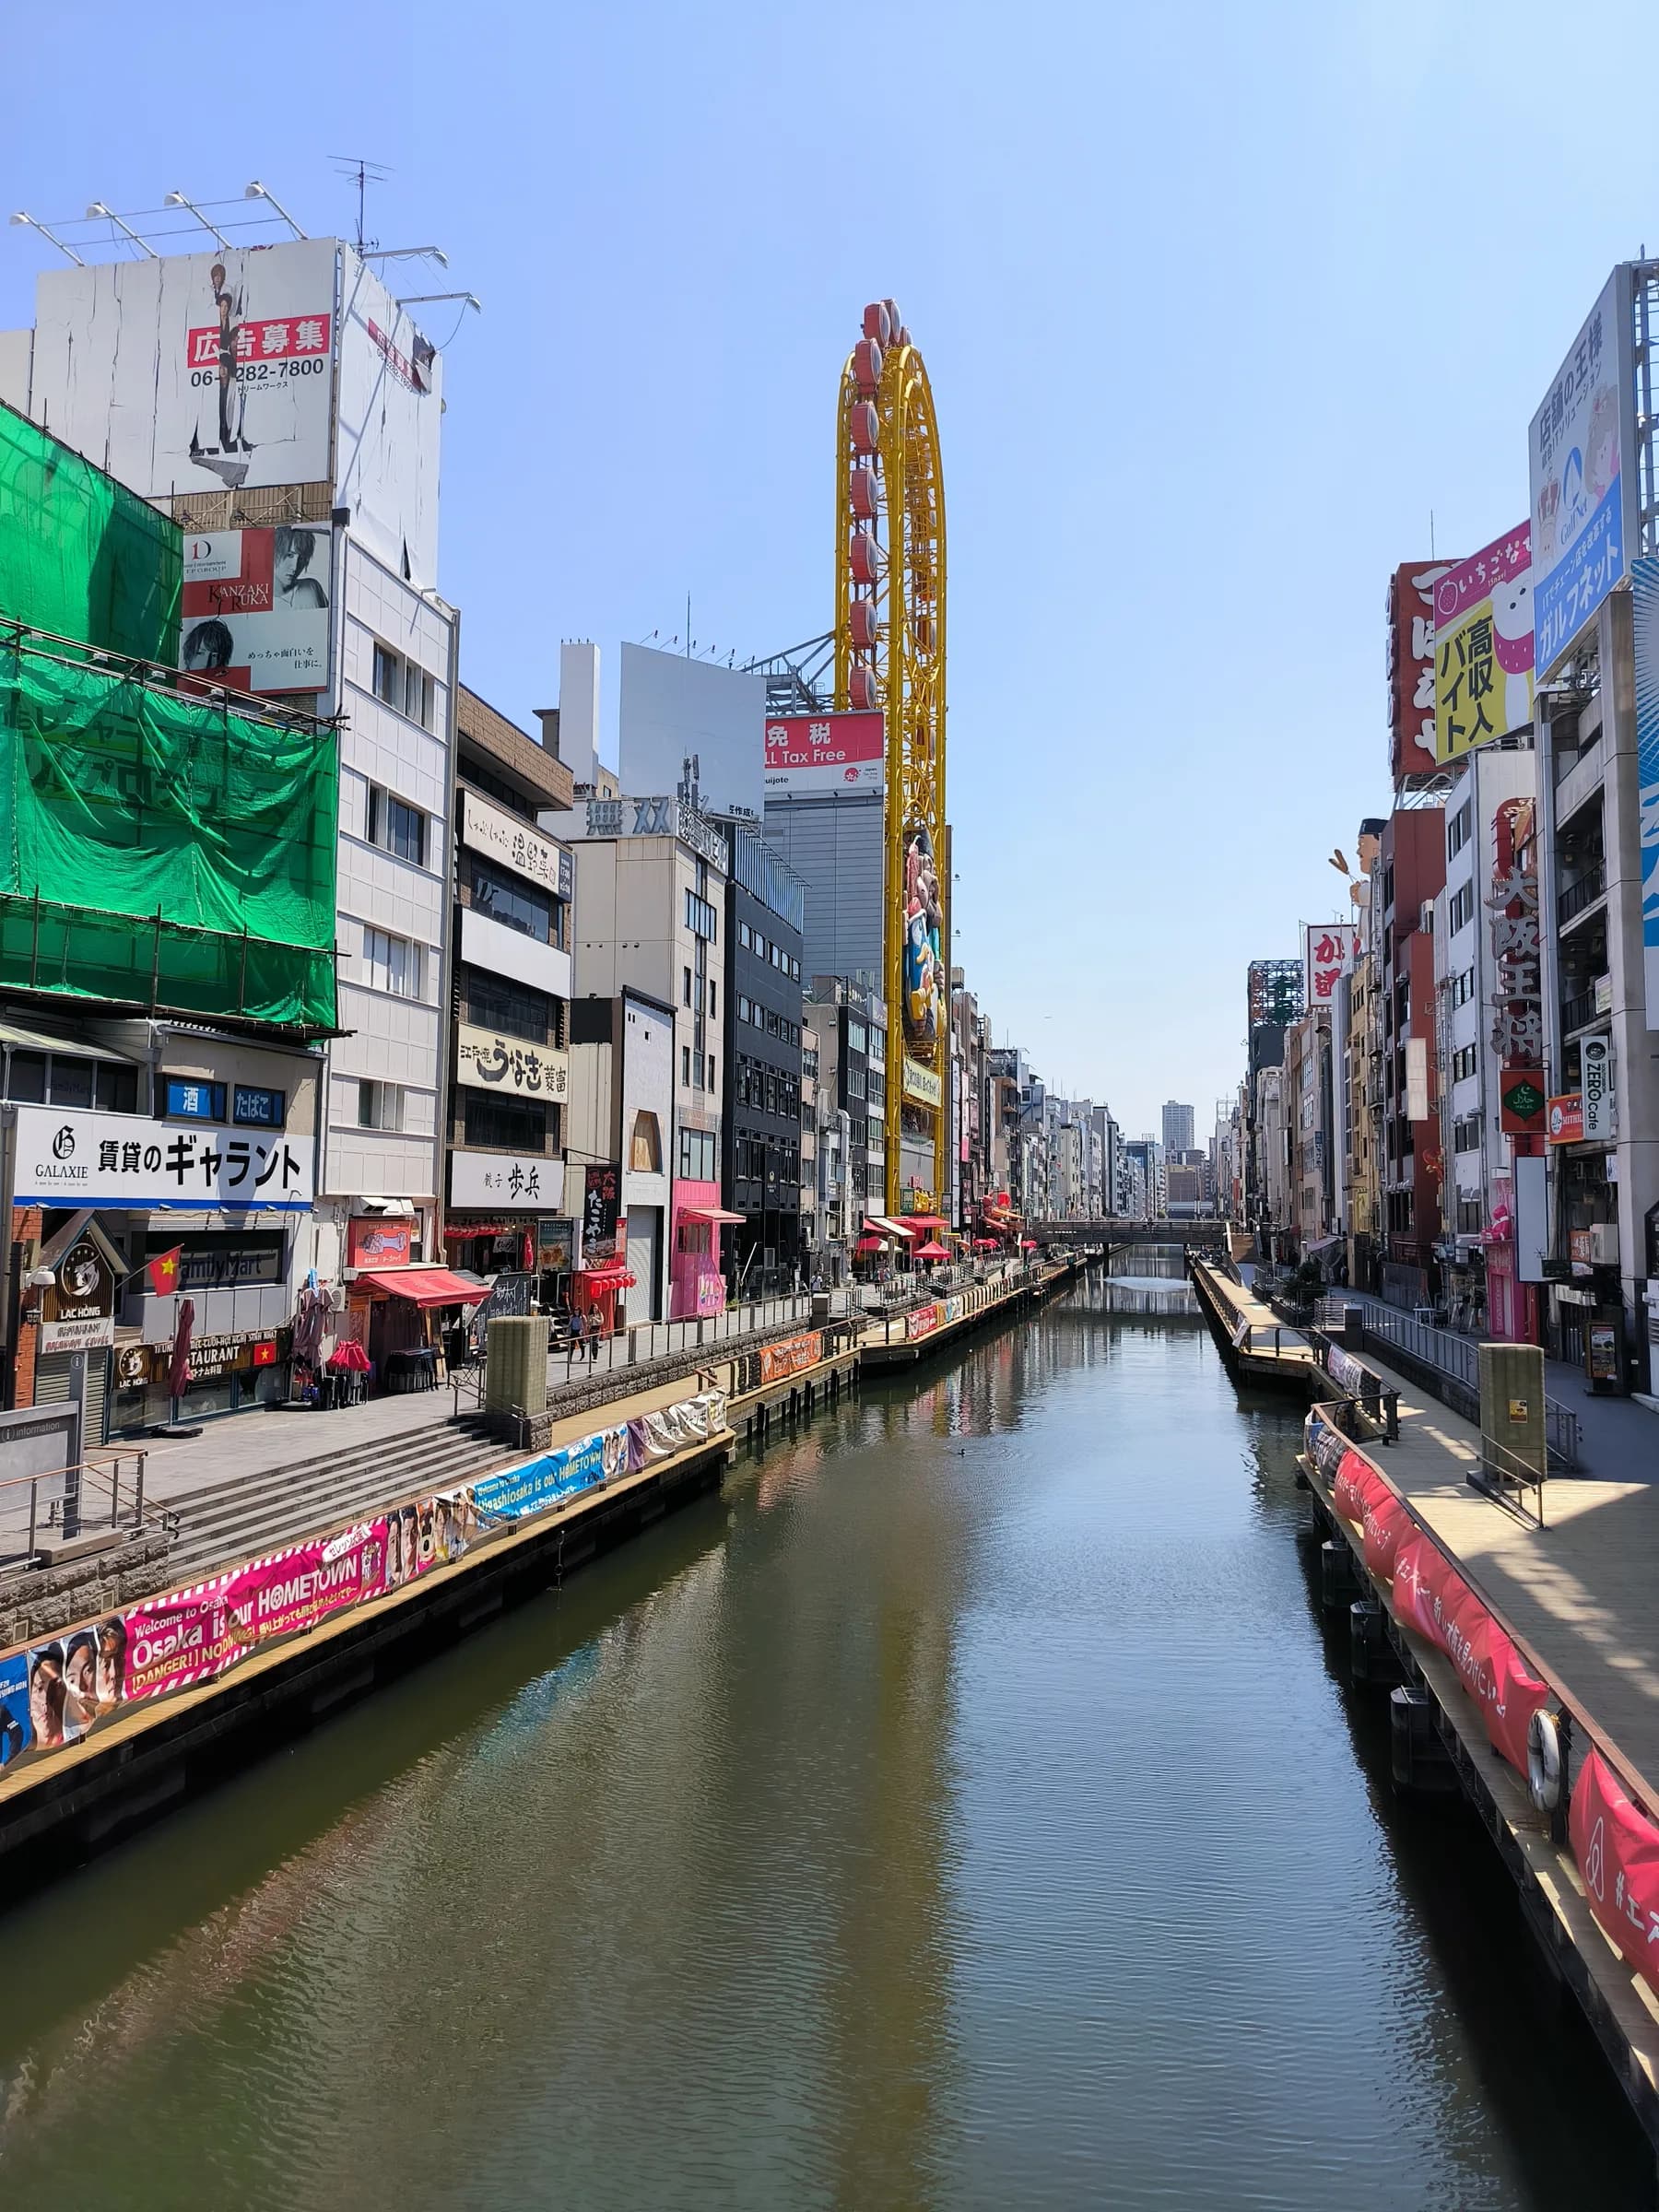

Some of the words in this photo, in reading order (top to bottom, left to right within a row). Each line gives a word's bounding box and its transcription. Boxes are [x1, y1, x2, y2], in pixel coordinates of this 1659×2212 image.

[194, 320, 324, 362] 広告募集
[191, 359, 323, 387] 06-282-7800
[1539, 312, 1603, 452] 店舗の王様
[208, 583, 269, 603] KANZAKI
[231, 593, 269, 611] RUKA
[1540, 532, 1618, 665] ガルフネット
[1440, 630, 1466, 754] バイト
[1466, 615, 1494, 743] 高収入
[767, 723, 831, 747] 免税
[764, 751, 777, 765] LL
[782, 750, 809, 764] Tax
[813, 749, 846, 762] Free
[765, 777, 789, 785] uijote
[1484, 866, 1542, 1058] 大阪王将
[1587, 1063, 1602, 1102] ZERO
[182, 1087, 199, 1113] 酒
[236, 1092, 270, 1120] たばこ
[1588, 1102, 1599, 1130] cafe
[35, 1164, 88, 1179] GALAXIE
[98, 1135, 301, 1189] 賃貸のギャラント
[181, 1253, 262, 1283] amilyMart
[16, 1422, 60, 1438] information
[535, 1476, 542, 1492] is
[559, 1450, 602, 1482] HOMETOWN
[133, 1624, 203, 1670] Osaka
[213, 1610, 226, 1639] is
[228, 1600, 254, 1630] our
[258, 1554, 358, 1617] HOMETOWN
[135, 1613, 182, 1640] Welcome
[185, 1607, 197, 1619] to
[200, 1594, 229, 1614] Osaka
